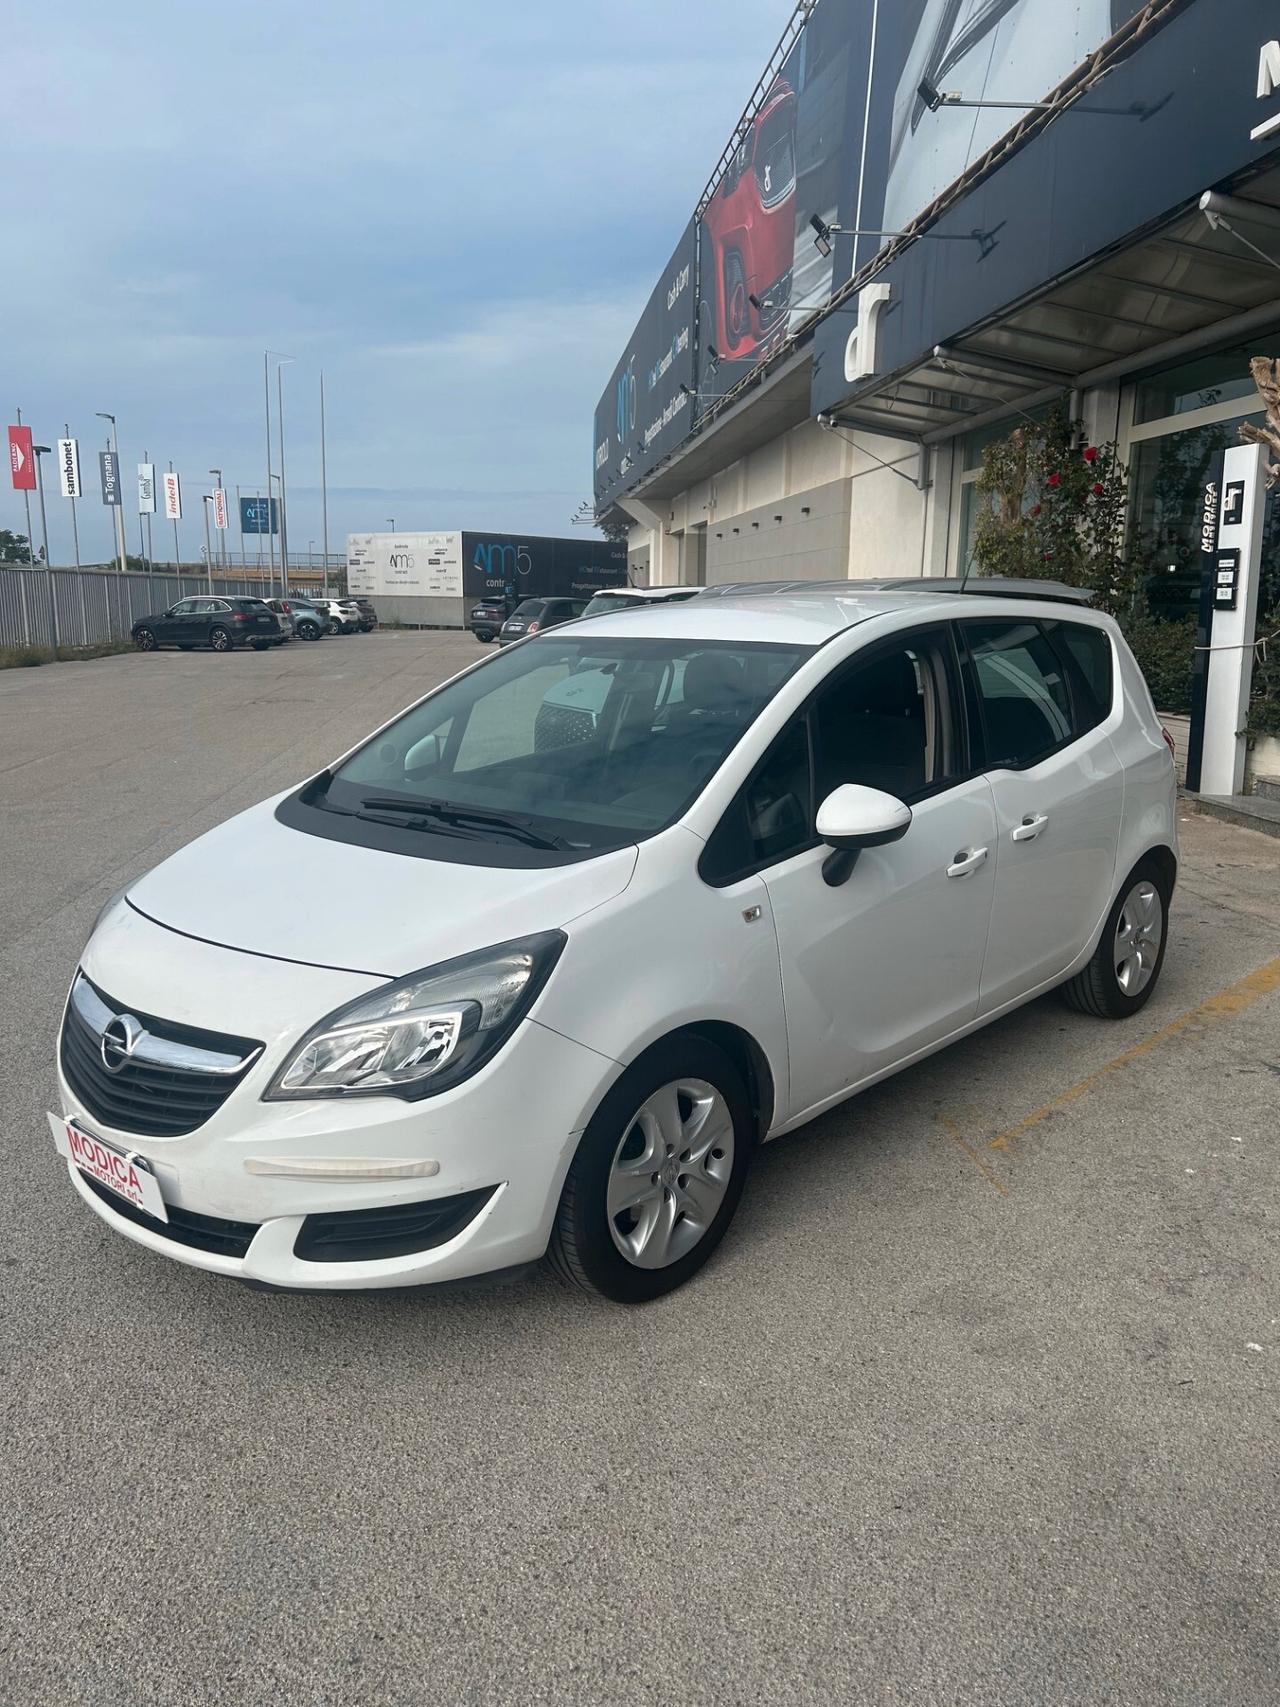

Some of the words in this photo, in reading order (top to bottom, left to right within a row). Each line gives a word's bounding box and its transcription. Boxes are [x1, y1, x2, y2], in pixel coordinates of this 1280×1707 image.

[62, 441, 76, 495] sambonet
[104, 454, 116, 493] Tognana
[1201, 482, 1216, 552] MODICA
[66, 1126, 143, 1194] MODICA
[94, 1167, 125, 1193] MOTORI
